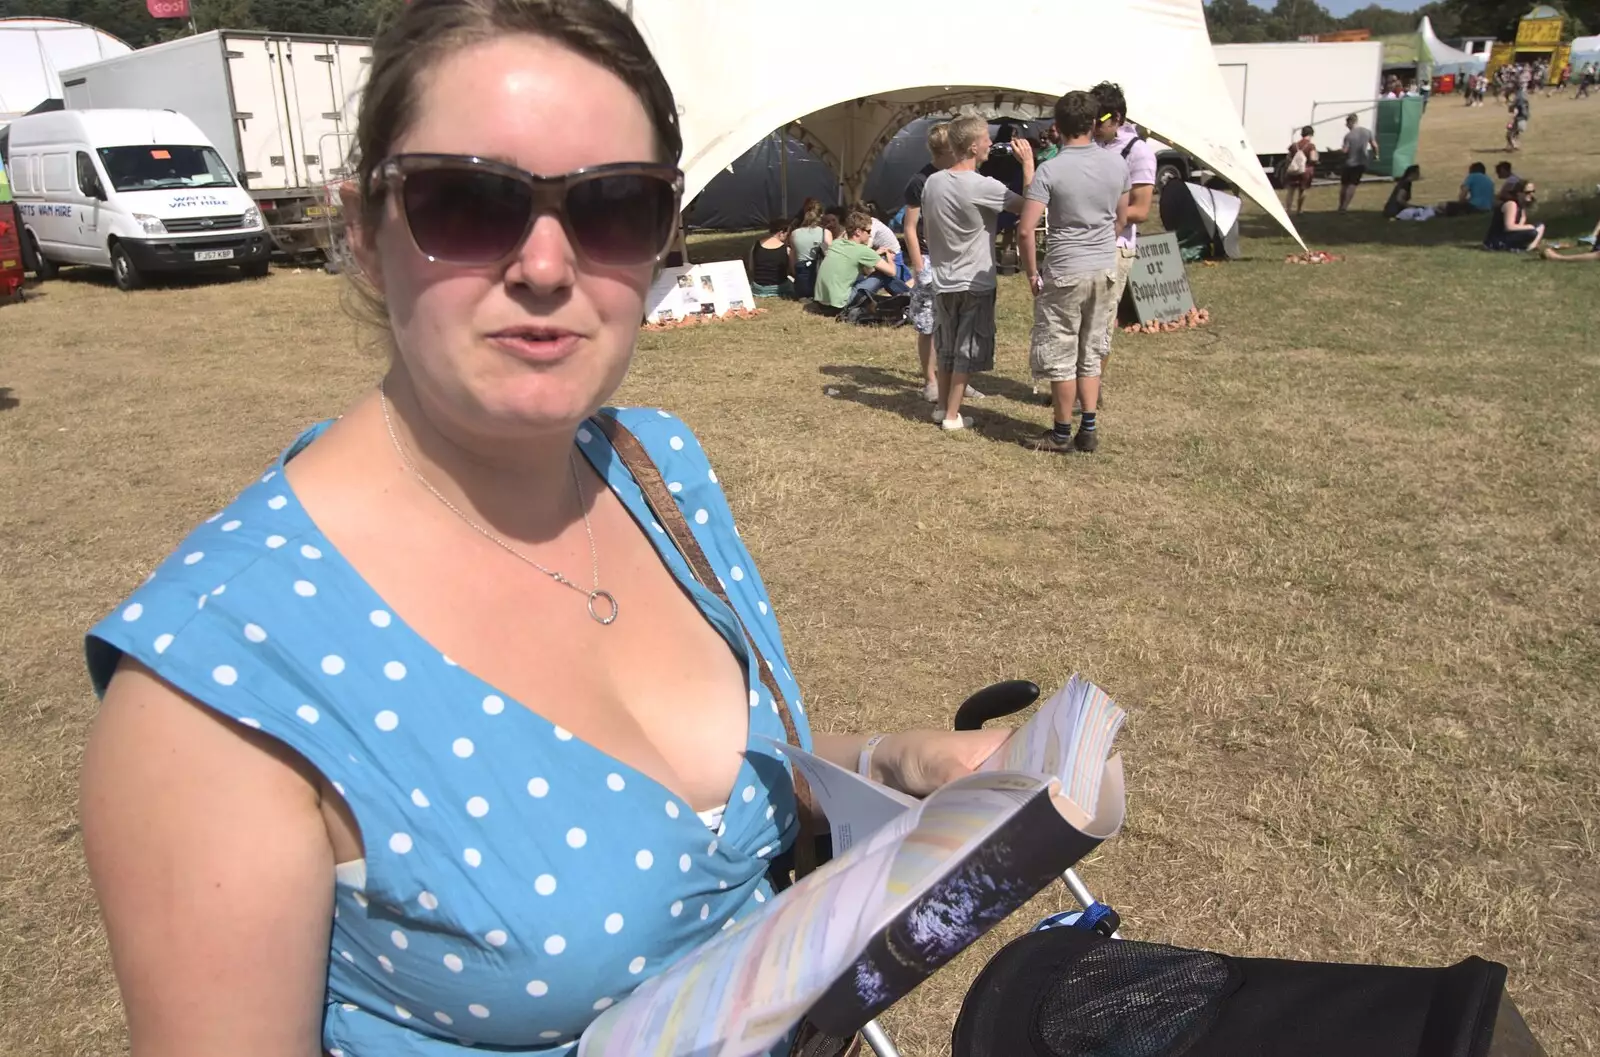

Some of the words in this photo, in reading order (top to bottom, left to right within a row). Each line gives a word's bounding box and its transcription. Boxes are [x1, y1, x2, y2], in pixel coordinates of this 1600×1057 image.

[19, 204, 35, 216] ATTS
[38, 204, 54, 217] VAN
[55, 205, 72, 217] HIRE
[1146, 261, 1164, 275] or
